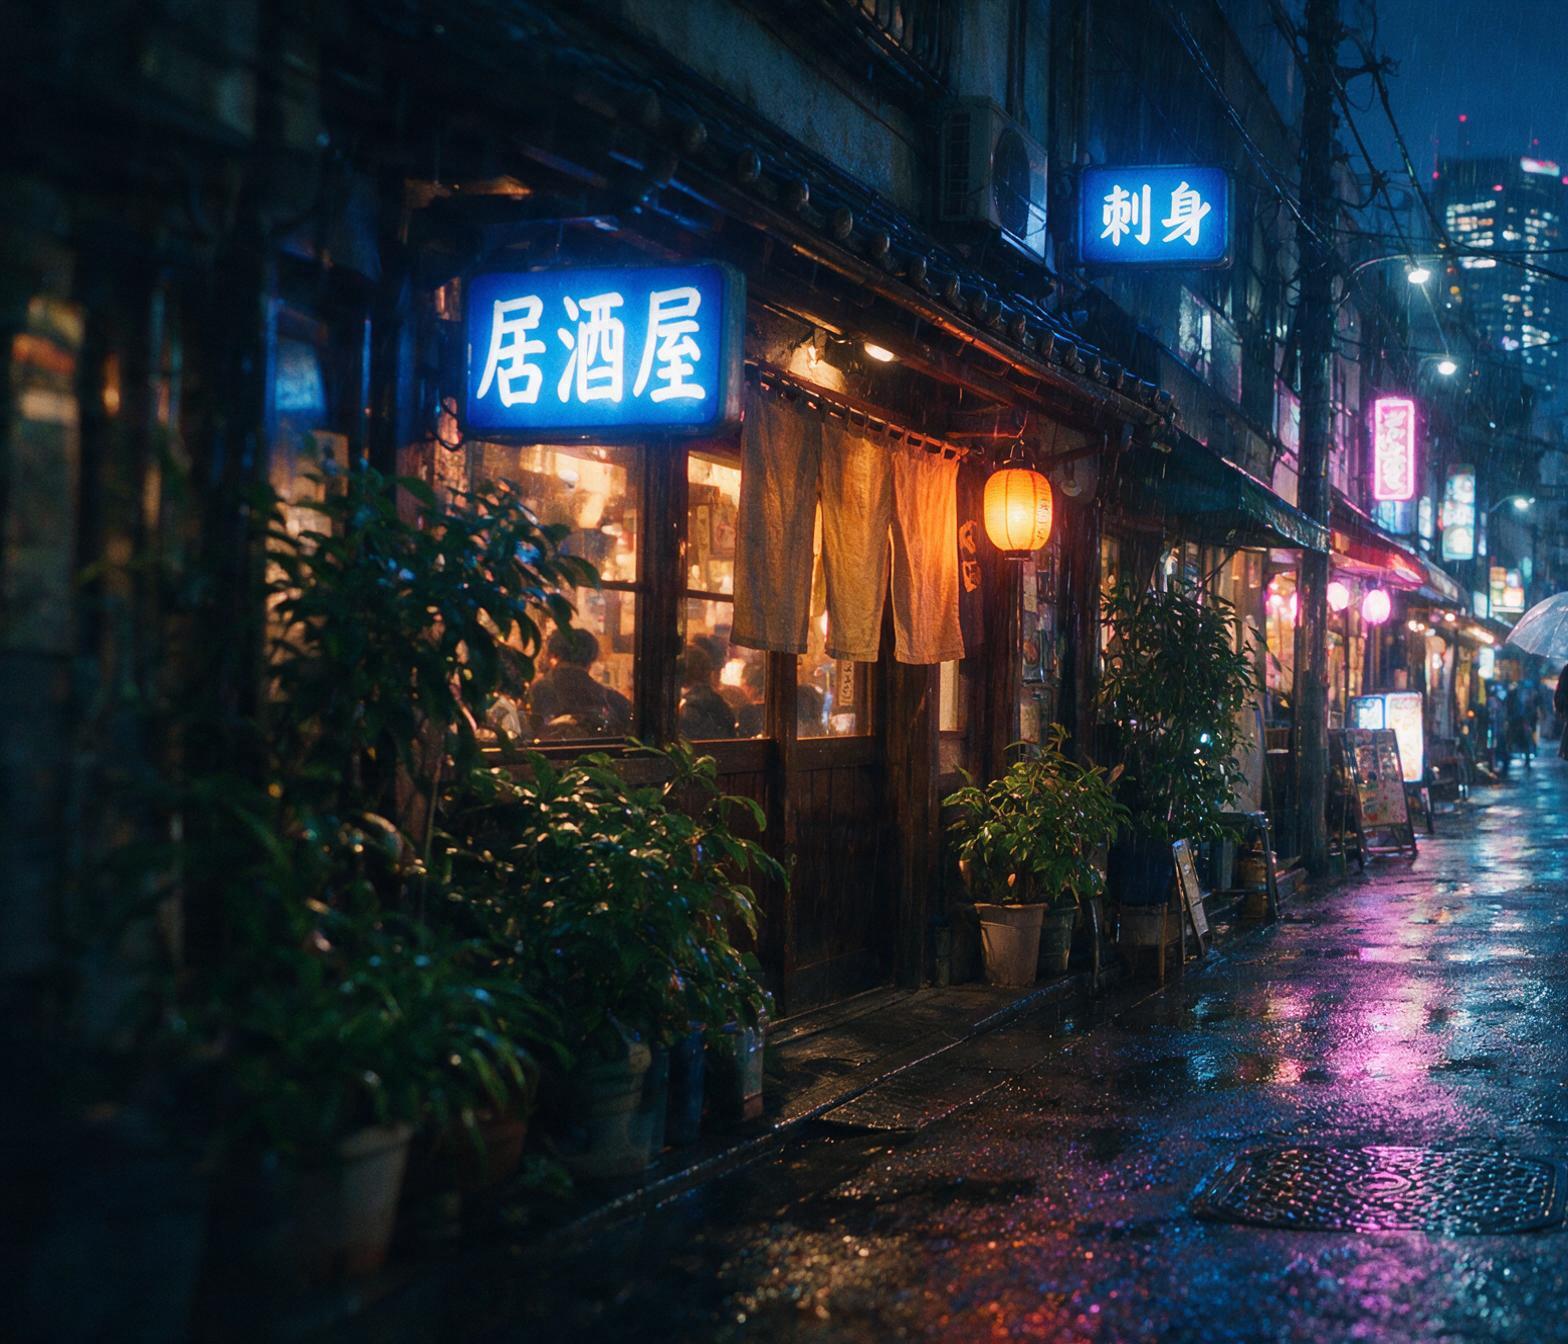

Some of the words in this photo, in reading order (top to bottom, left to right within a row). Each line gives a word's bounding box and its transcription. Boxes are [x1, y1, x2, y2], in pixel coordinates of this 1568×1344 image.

[1101, 182, 1210, 246] 刺身
[477, 287, 705, 407] 居酒屋
